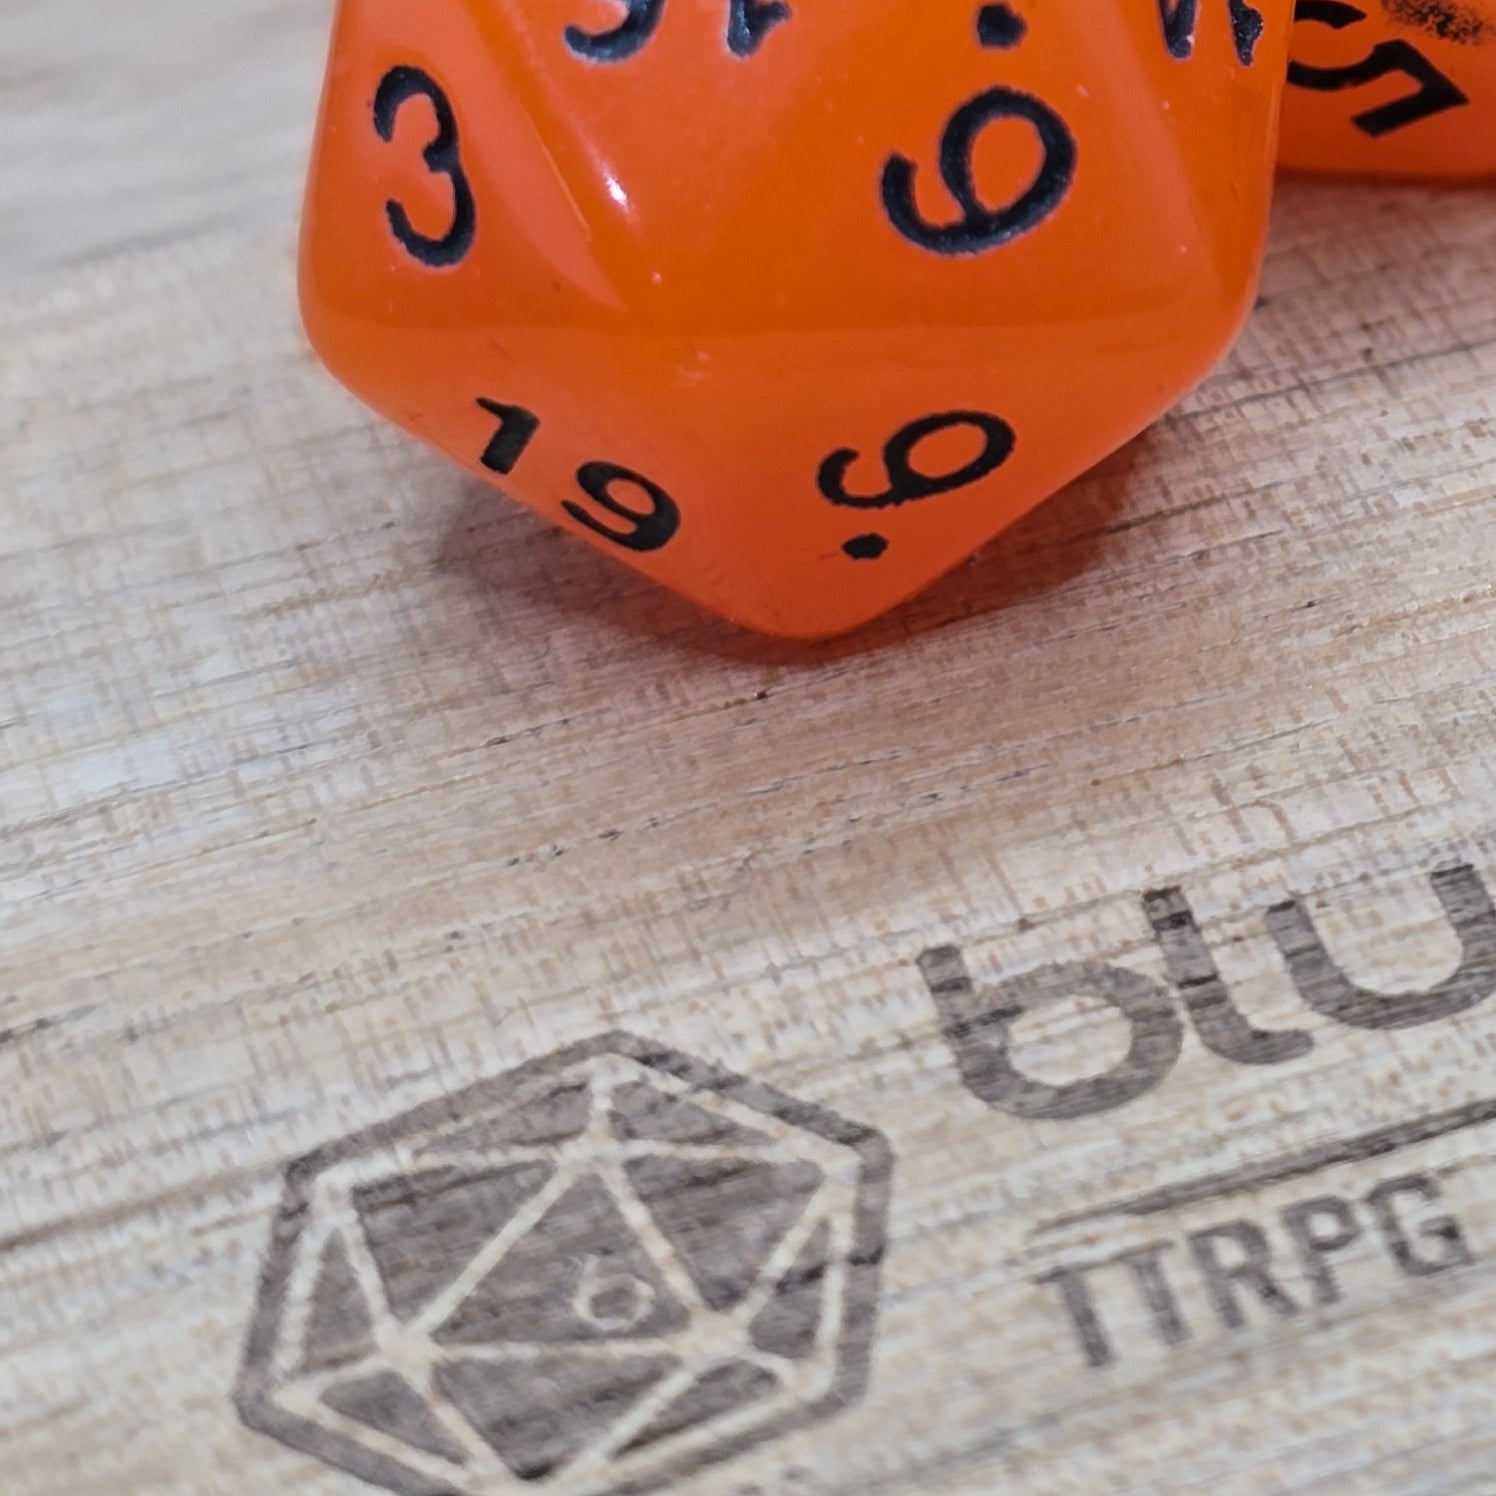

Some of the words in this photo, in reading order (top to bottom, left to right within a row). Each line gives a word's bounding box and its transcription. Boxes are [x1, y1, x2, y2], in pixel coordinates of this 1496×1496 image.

[372, 64, 477, 268] 3
[475, 396, 682, 553] 19
[1034, 1168, 1476, 1370] TTRPG
